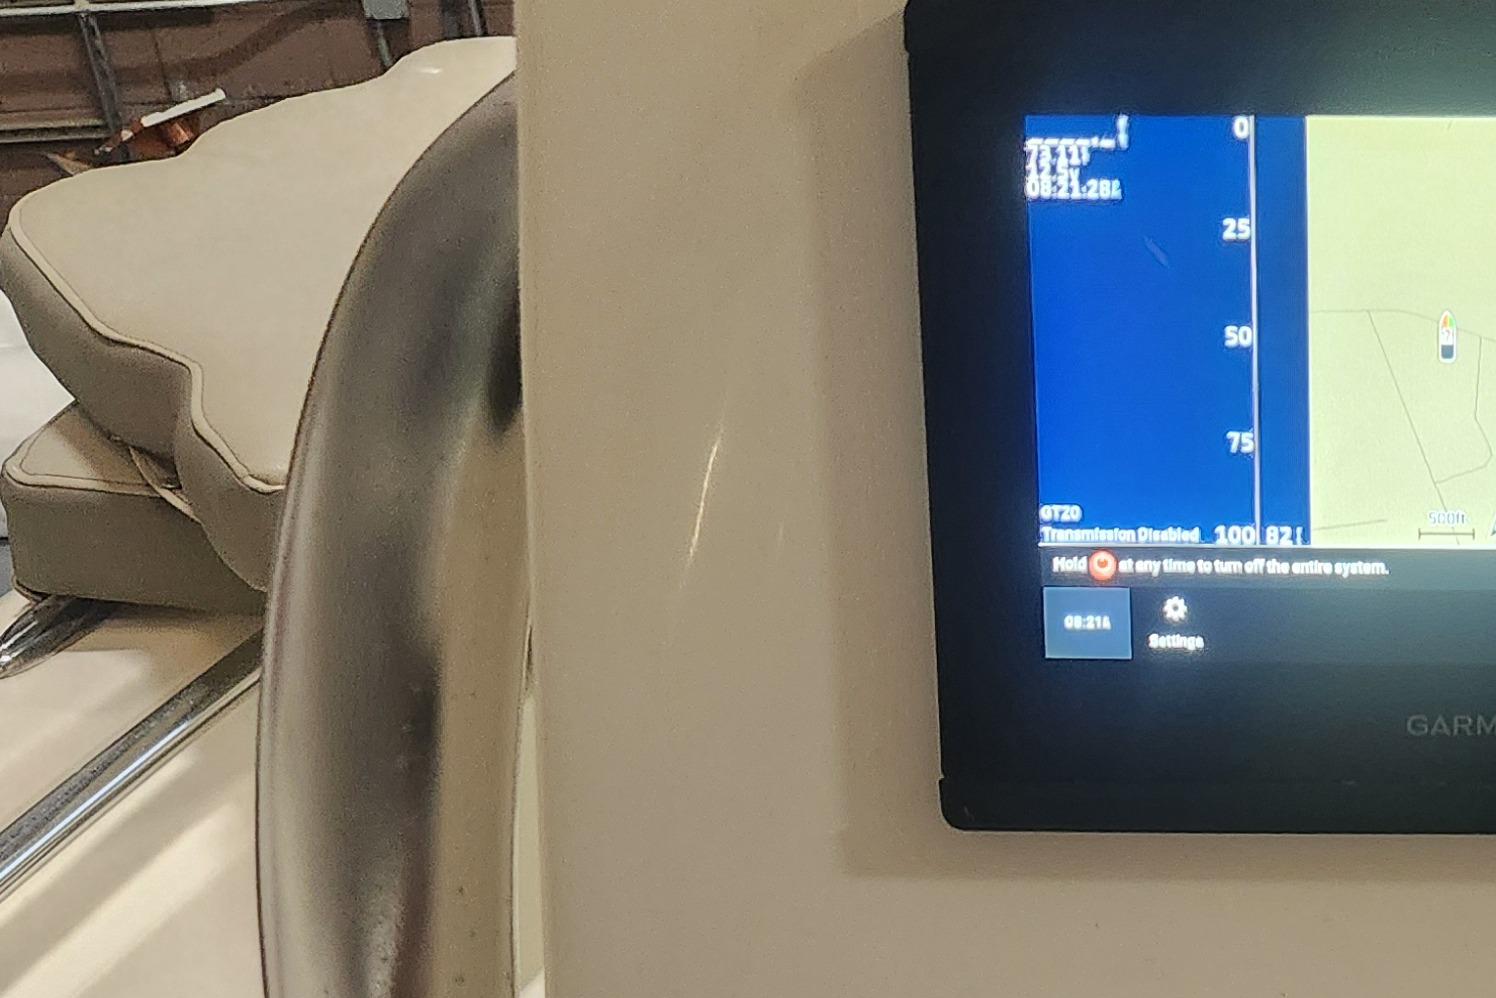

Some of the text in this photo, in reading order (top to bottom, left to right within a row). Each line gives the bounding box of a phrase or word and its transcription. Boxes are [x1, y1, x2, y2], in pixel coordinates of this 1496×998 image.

[1233, 116, 1249, 140] 0
[1223, 218, 1251, 240] 25
[1224, 325, 1252, 347] 50
[1226, 431, 1255, 454] 75
[1041, 526, 1200, 543] Transmission Disabled
[1215, 525, 1256, 546] 100
[1053, 556, 1389, 578] Hold at any time to turn off the entire system.
[1064, 614, 1112, 630] 08:21A
[1149, 633, 1204, 650] Settings
